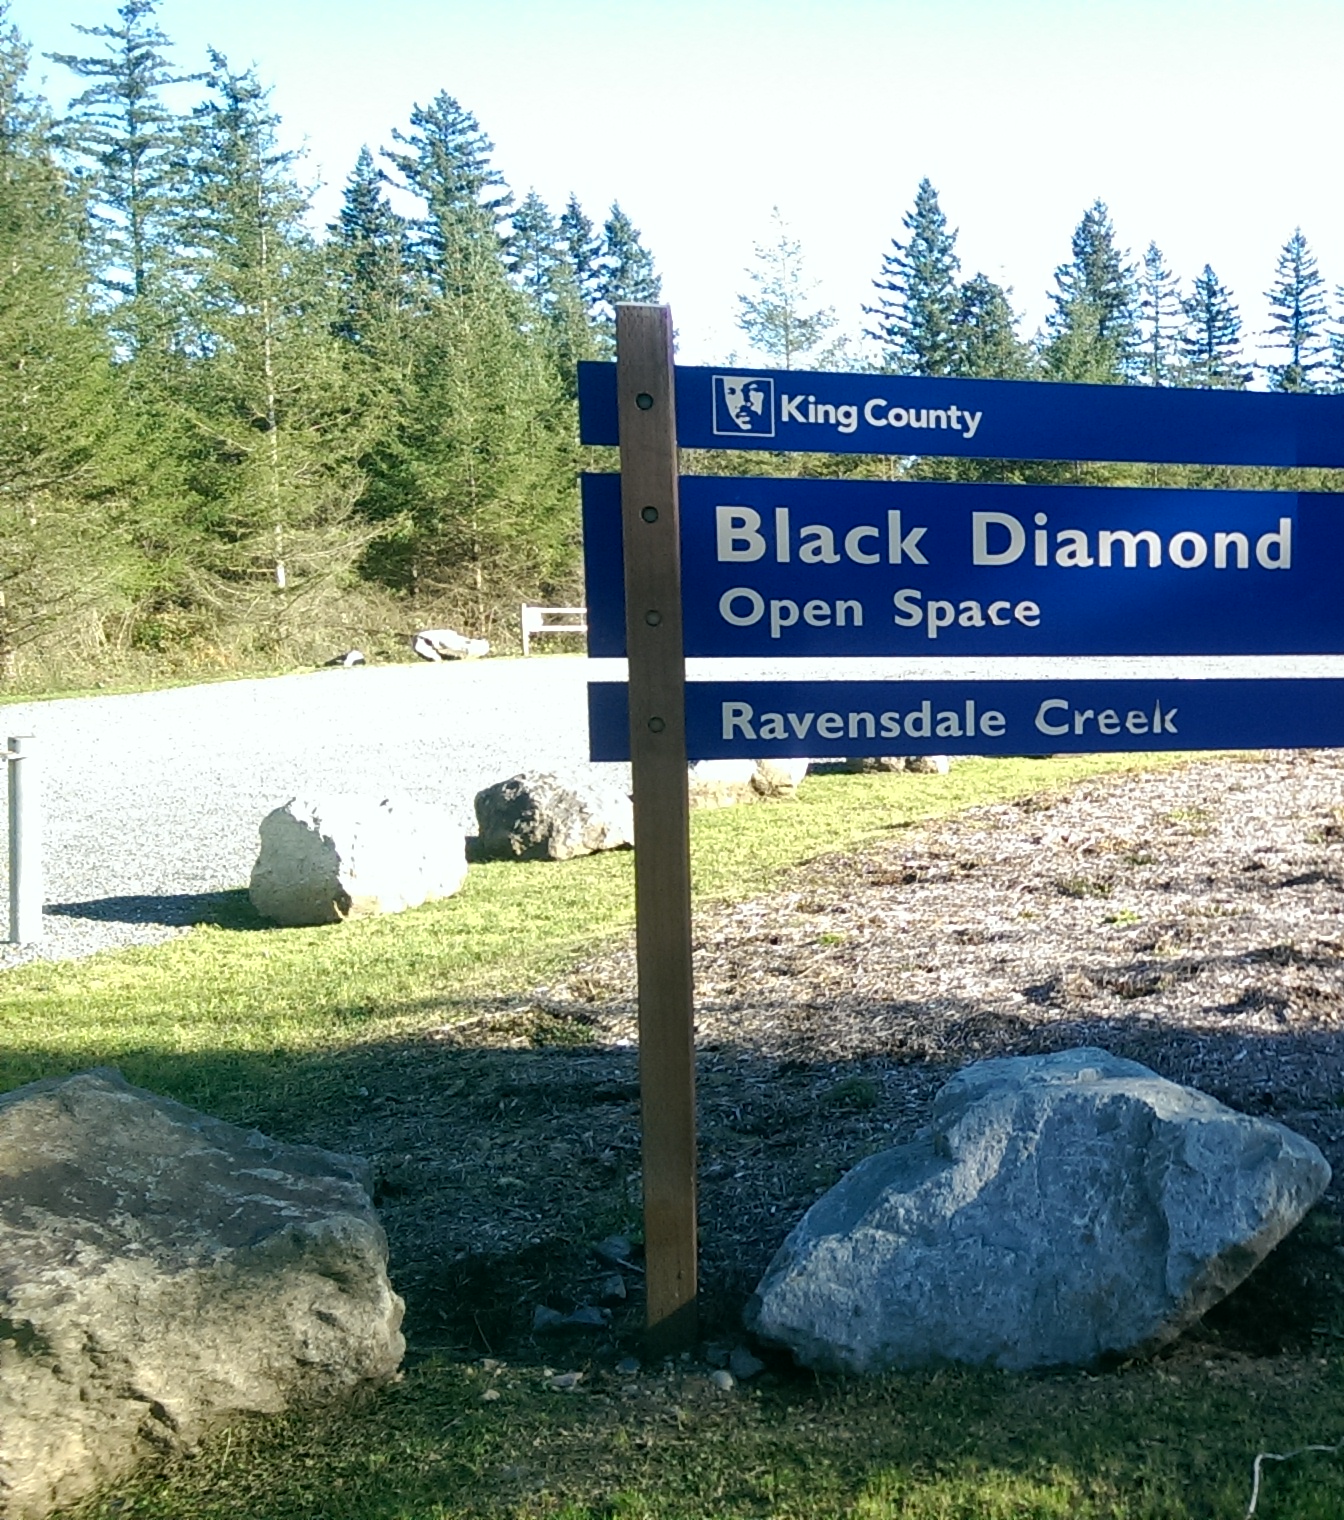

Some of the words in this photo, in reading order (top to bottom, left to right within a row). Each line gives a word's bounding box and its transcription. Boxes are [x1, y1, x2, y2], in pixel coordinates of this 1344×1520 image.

[781, 394, 858, 434] King
[863, 398, 983, 439] County
[715, 505, 929, 565] Black
[972, 511, 1292, 570] Diamond
[719, 587, 863, 638] Open
[893, 588, 1041, 639] Space
[722, 700, 1006, 740] Ravensdale
[1034, 698, 1178, 736] Creek
